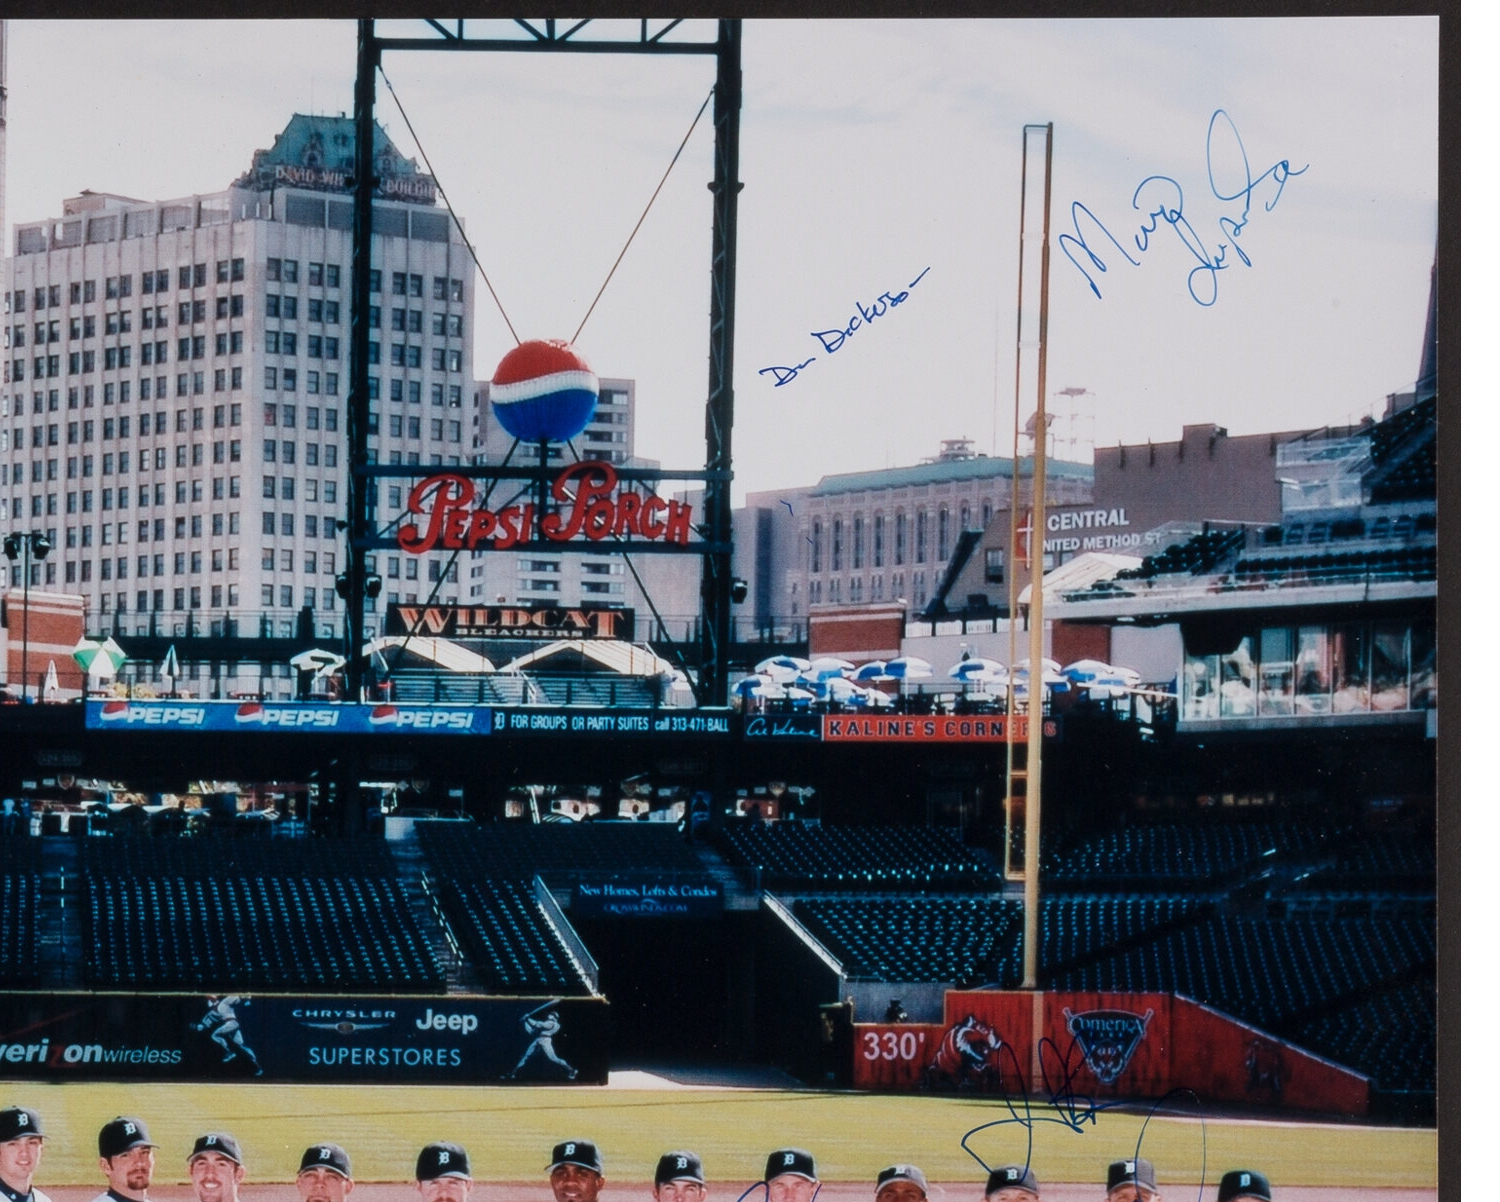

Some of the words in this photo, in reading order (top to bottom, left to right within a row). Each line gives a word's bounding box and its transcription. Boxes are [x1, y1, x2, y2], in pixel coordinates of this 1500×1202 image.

[1047, 508, 1130, 531] CENTRAL
[1043, 538, 1080, 552] NITED
[1083, 533, 1161, 550] METHODST
[397, 607, 625, 639] WILDCAT
[455, 628, 583, 638] BLEACHERS
[127, 707, 205, 725] PEPSI
[262, 709, 340, 727] PEPSI
[397, 710, 474, 728] PEPSI
[510, 714, 528, 729] FOR
[531, 715, 567, 730] GROUPS
[572, 716, 585, 730] OR
[587, 716, 615, 730] PARTY
[617, 716, 649, 731] SUITES
[655, 717, 669, 731] call
[672, 717, 729, 732] 313-471-BALL
[828, 720, 936, 737] KALINE'S
[580, 884, 600, 896] New
[292, 1009, 396, 1018] CHRYSLER
[415, 1008, 478, 1035] Jeep
[863, 1032, 925, 1060] 330'
[309, 1047, 461, 1067] SUPERSTORES
